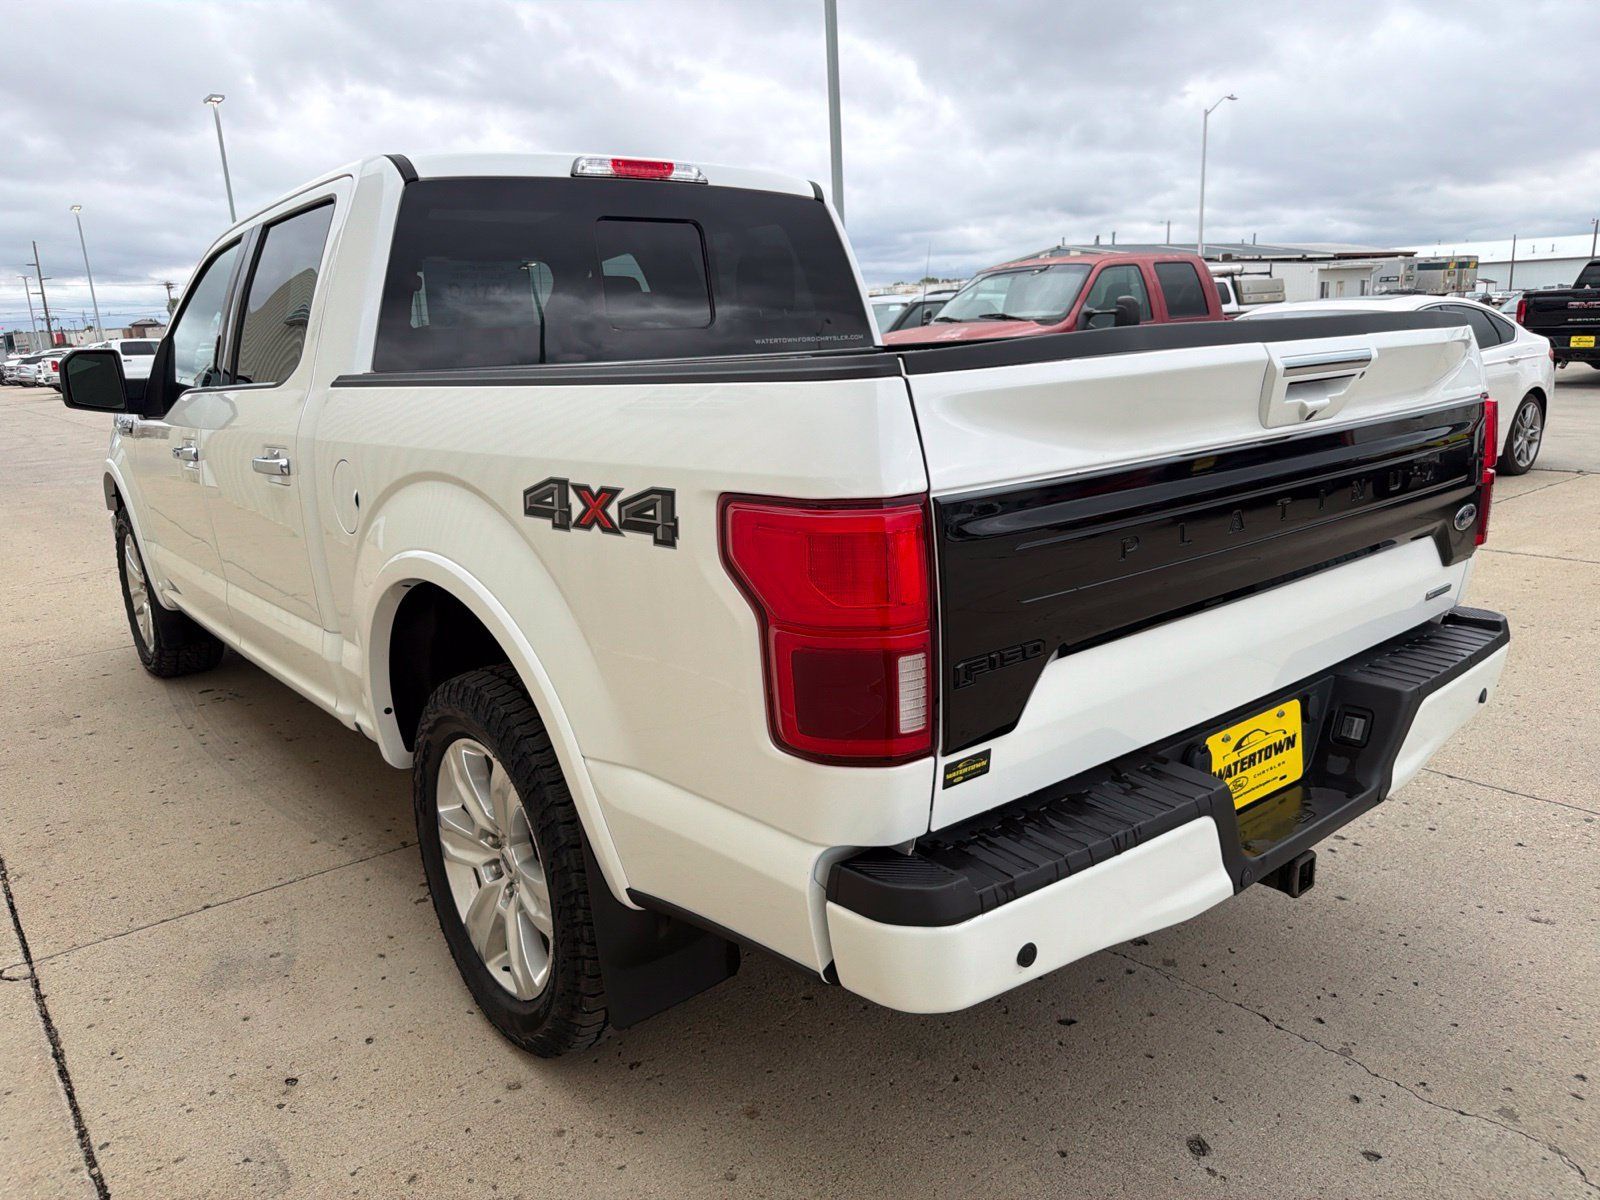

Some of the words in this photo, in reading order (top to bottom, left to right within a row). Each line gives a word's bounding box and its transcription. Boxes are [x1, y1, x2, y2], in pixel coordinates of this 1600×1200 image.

[754, 334, 864, 345] WATERTOWNFORDCHRYSLER.COM
[945, 759, 988, 780] WATERTOWN
[1253, 760, 1286, 779] CHRYSLER
